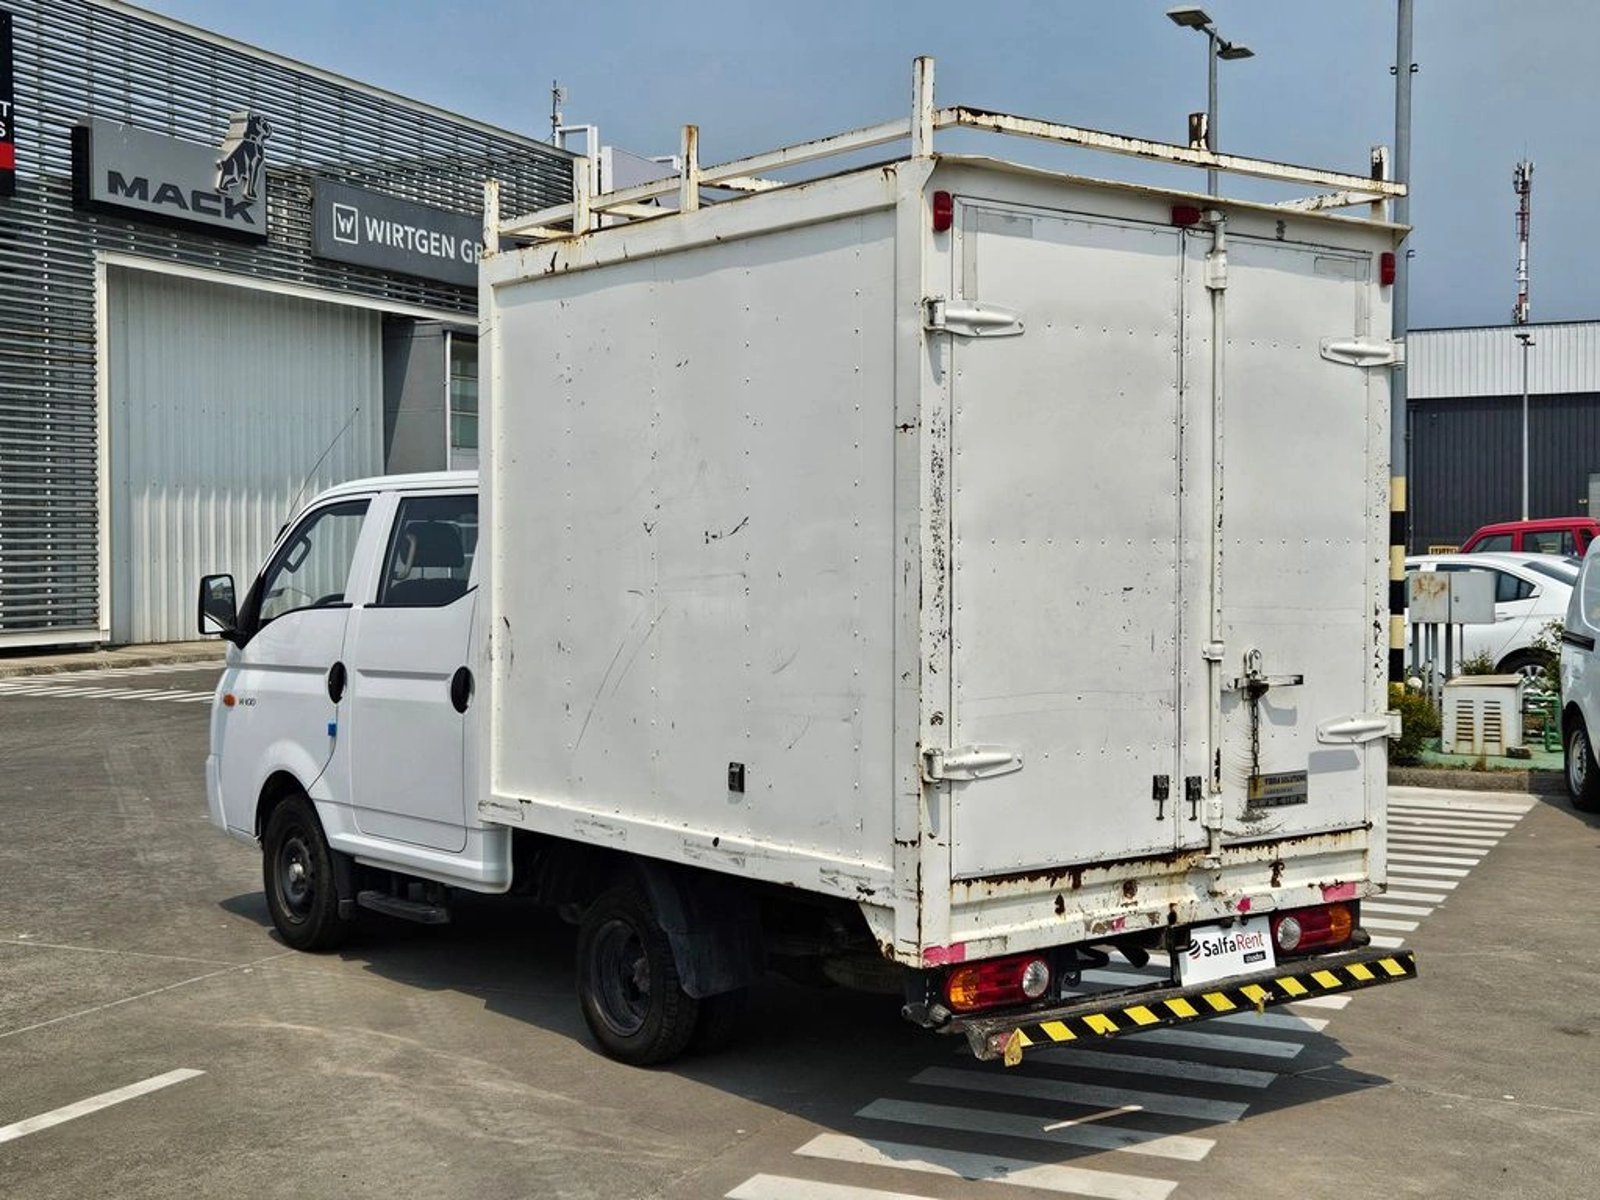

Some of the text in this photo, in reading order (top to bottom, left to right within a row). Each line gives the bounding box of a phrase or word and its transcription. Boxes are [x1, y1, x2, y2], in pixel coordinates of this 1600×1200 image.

[107, 170, 256, 225] MACK
[365, 215, 456, 260] WIRTGEN
[1202, 930, 1265, 957] SalfaRent
